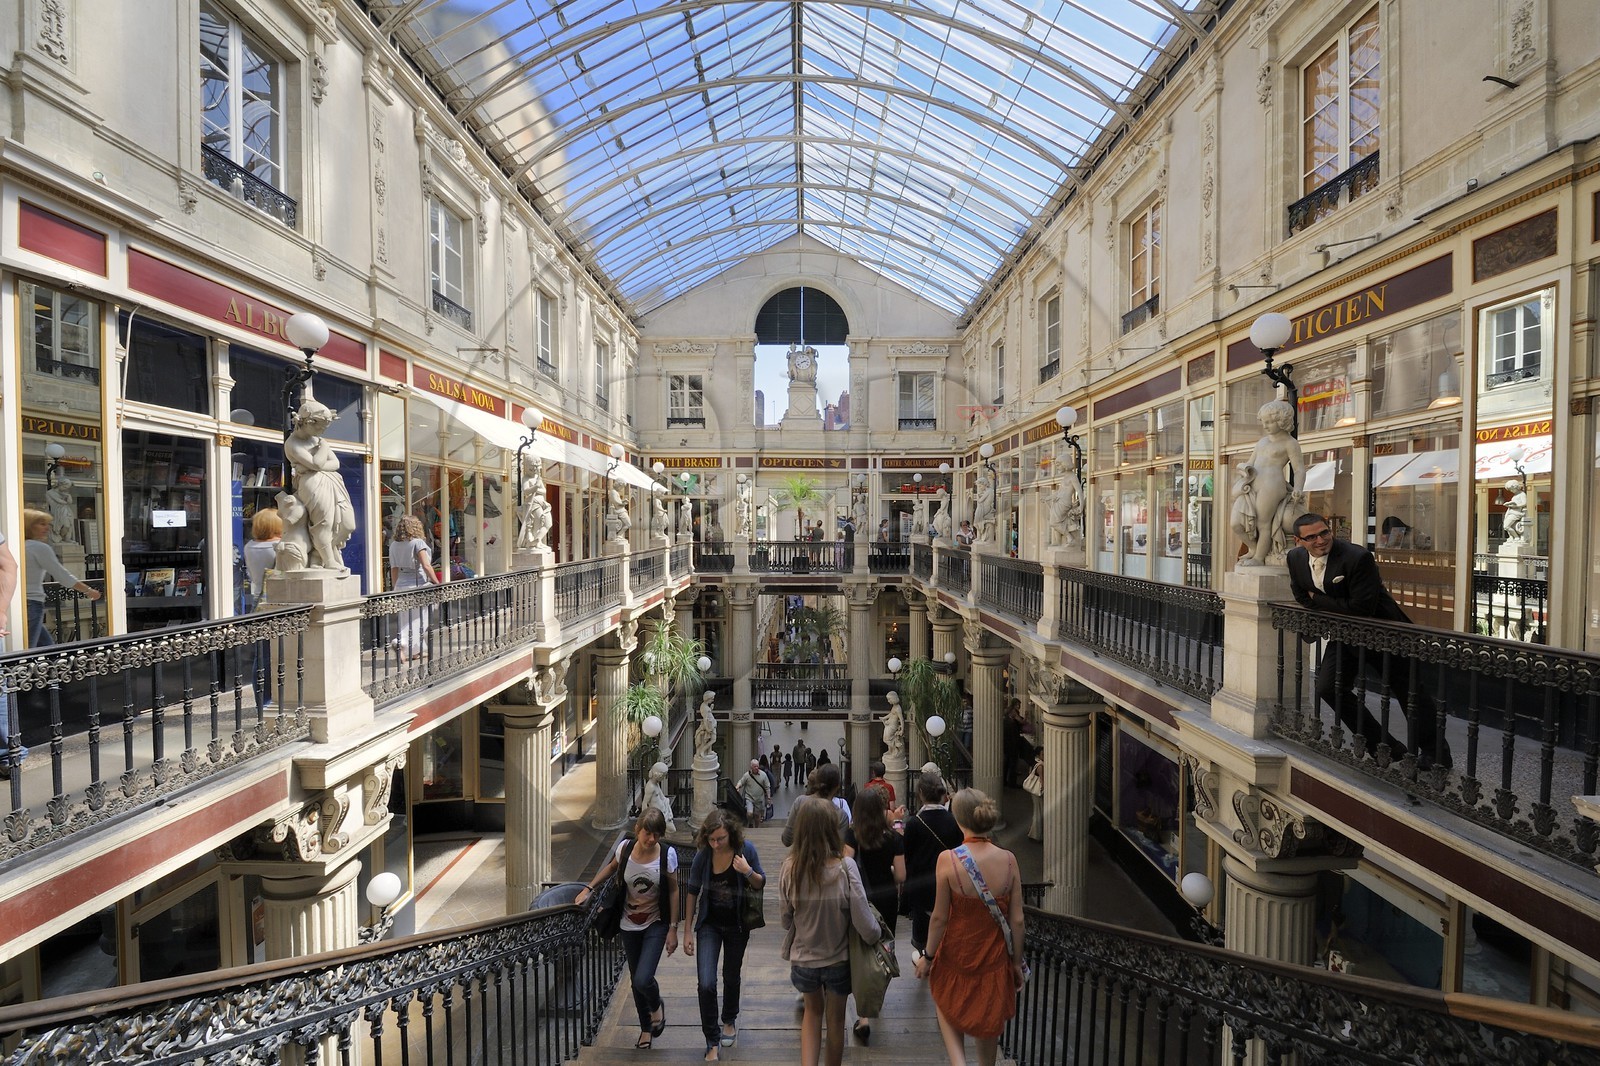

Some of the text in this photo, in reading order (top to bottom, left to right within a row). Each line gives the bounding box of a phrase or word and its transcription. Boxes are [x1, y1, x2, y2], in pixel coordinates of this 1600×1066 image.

[223, 296, 291, 341] ALBU
[1281, 284, 1389, 348] TICIEN
[429, 373, 495, 412] SALSA NOVA
[537, 420, 572, 441] ALSA NOVA
[1026, 420, 1062, 443] MUTUALIS
[684, 458, 721, 467] BRASIL
[762, 457, 825, 467] OPTICIEN
